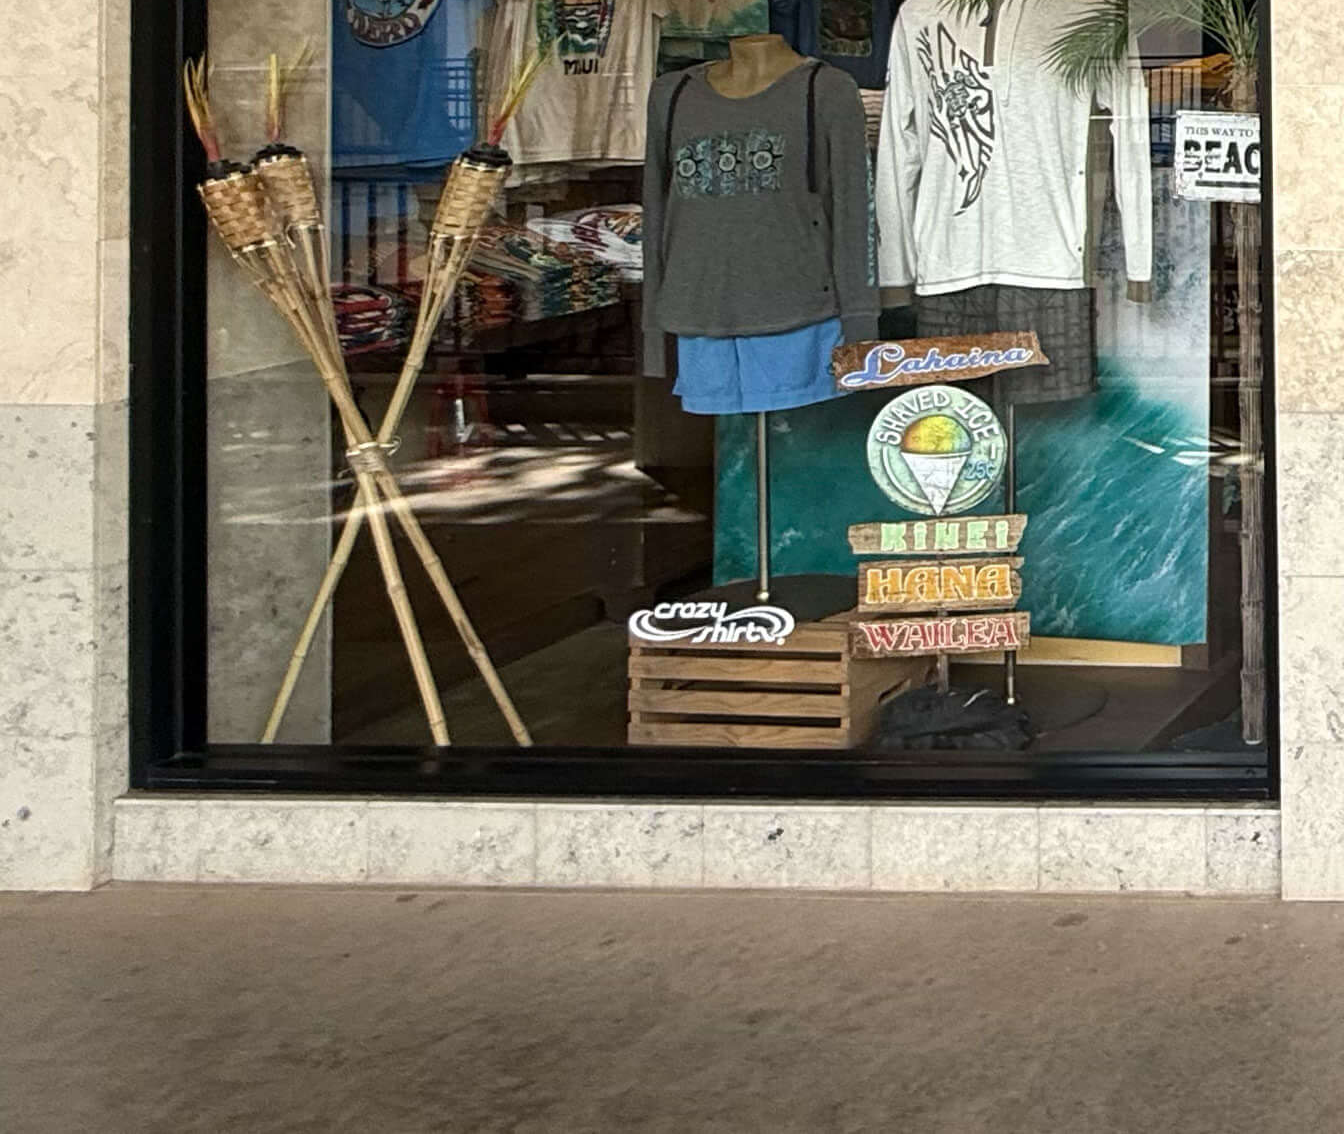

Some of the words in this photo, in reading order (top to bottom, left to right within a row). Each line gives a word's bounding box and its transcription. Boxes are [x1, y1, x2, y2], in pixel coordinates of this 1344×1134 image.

[1211, 127, 1235, 138] WAY
[1238, 128, 1254, 138] TO
[840, 343, 1034, 387] Lahaina
[875, 390, 951, 446] SHAVED
[953, 396, 1000, 443] ICE
[865, 564, 1014, 604] HANA
[654, 602, 728, 622] crazy
[858, 617, 1020, 652] WAILEA
